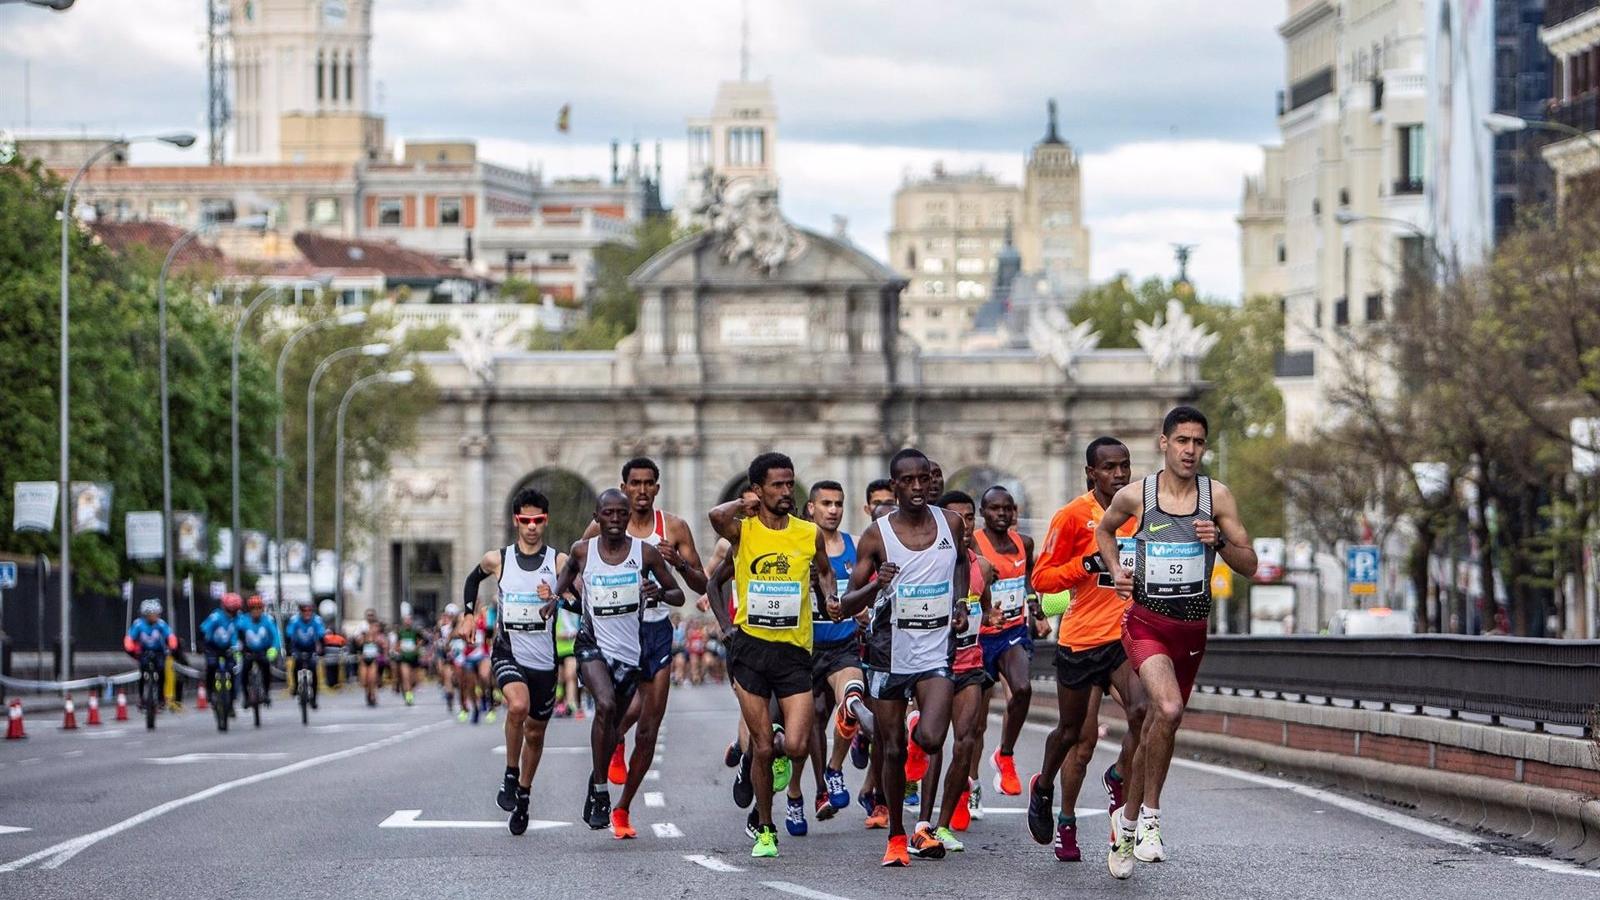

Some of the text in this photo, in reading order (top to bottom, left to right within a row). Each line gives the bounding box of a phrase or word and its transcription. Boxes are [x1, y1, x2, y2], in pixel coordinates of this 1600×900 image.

[1166, 545, 1200, 555] movistar
[1122, 557, 1134, 567] 48
[1355, 552, 1374, 577] P
[1169, 564, 1183, 574] 52
[766, 584, 796, 593] movistar
[917, 586, 946, 595] movistar
[612, 590, 618, 599] 8
[1009, 594, 1015, 602] 9
[767, 600, 780, 609] 38
[921, 603, 929, 612] 4
[522, 608, 528, 616] 2
